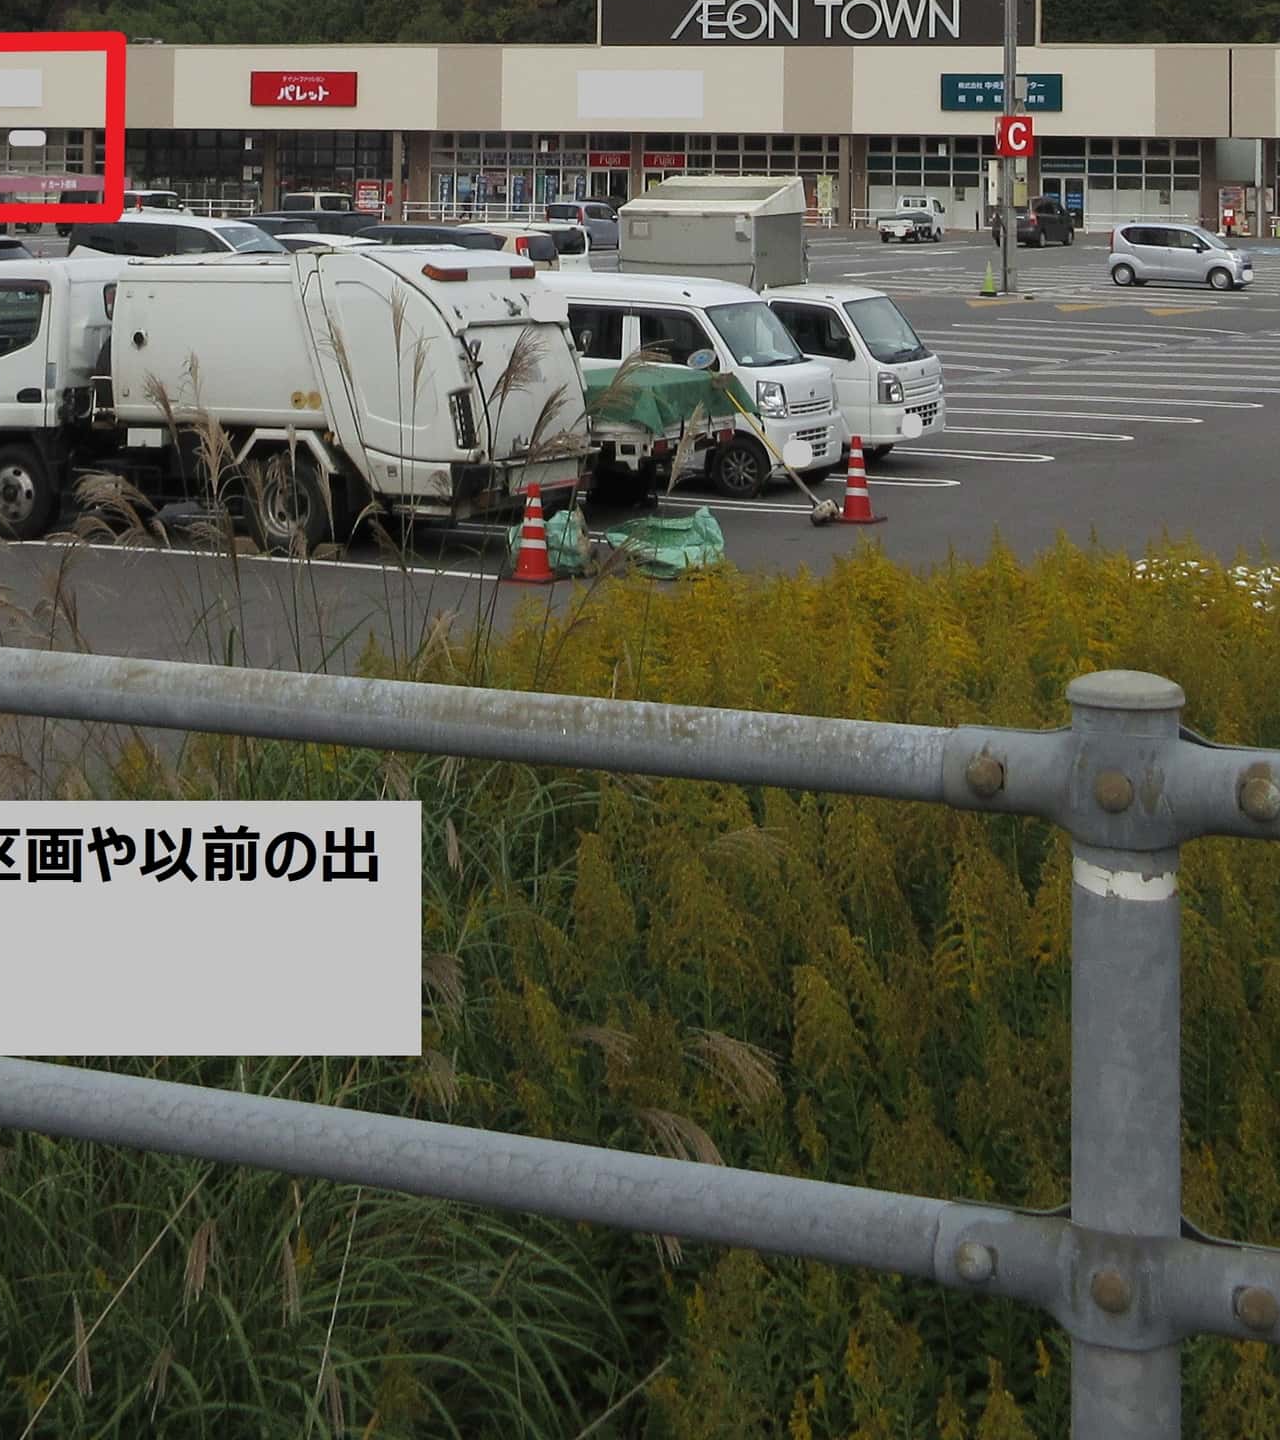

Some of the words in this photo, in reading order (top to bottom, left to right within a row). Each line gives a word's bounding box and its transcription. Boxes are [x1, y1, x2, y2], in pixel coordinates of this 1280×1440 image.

[277, 84, 329, 102] パレット
[1008, 122, 1027, 150] C
